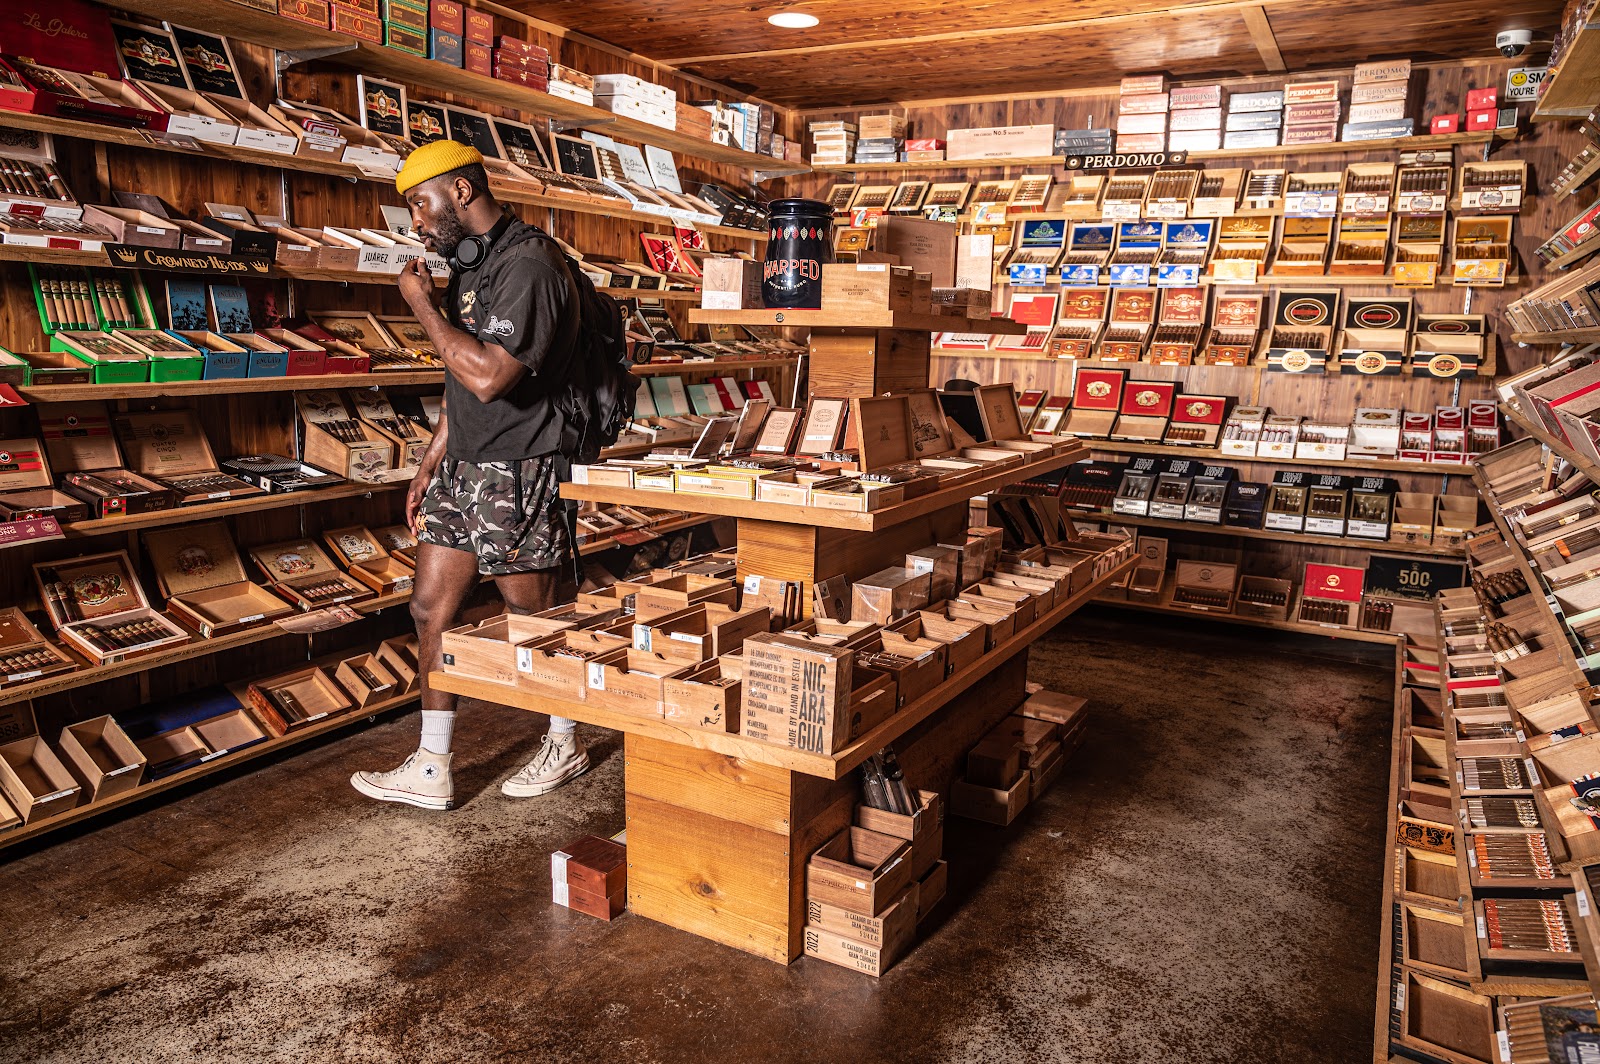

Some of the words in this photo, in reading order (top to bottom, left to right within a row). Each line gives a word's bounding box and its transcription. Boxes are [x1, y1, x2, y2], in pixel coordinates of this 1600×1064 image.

[438, 3, 458, 17] ENCLAVE
[23, 12, 42, 29] La
[46, 18, 89, 40] Galera
[470, 15, 489, 28] ENCLAVE
[438, 35, 458, 48] ENCLAVE
[470, 48, 488, 60] ENCLAVE
[1359, 66, 1406, 77] PERDOMO
[1289, 88, 1323, 97] PERDOMO
[1509, 87, 1535, 96] YOU'RE
[1288, 130, 1321, 138] PERDOMO
[1083, 153, 1165, 168] PERDOMO
[144, 249, 206, 269] CROWNED
[208, 255, 248, 273] HEADS
[363, 252, 389, 264] JUÁREZ
[764, 259, 820, 282] WARPED
[218, 290, 243, 299] ENCLAVE
[213, 357, 241, 366] ENCLAVE
[256, 357, 282, 367] ENCLAVE
[803, 660, 827, 694] NIC
[606, 687, 646, 700] eanderthal
[791, 682, 800, 692] IN
[790, 694, 799, 714] HAND
[799, 691, 826, 726] ARA
[790, 716, 798, 727] BY
[788, 728, 797, 748] MADE
[798, 722, 824, 755] GUA
[810, 902, 822, 924] 2022
[852, 921, 861, 930] GRAN
[862, 924, 879, 934] CORONAS
[872, 919, 880, 928] LAS
[807, 931, 818, 954] 2022
[849, 951, 858, 959] GRAN
[860, 954, 876, 966] CORONAS
